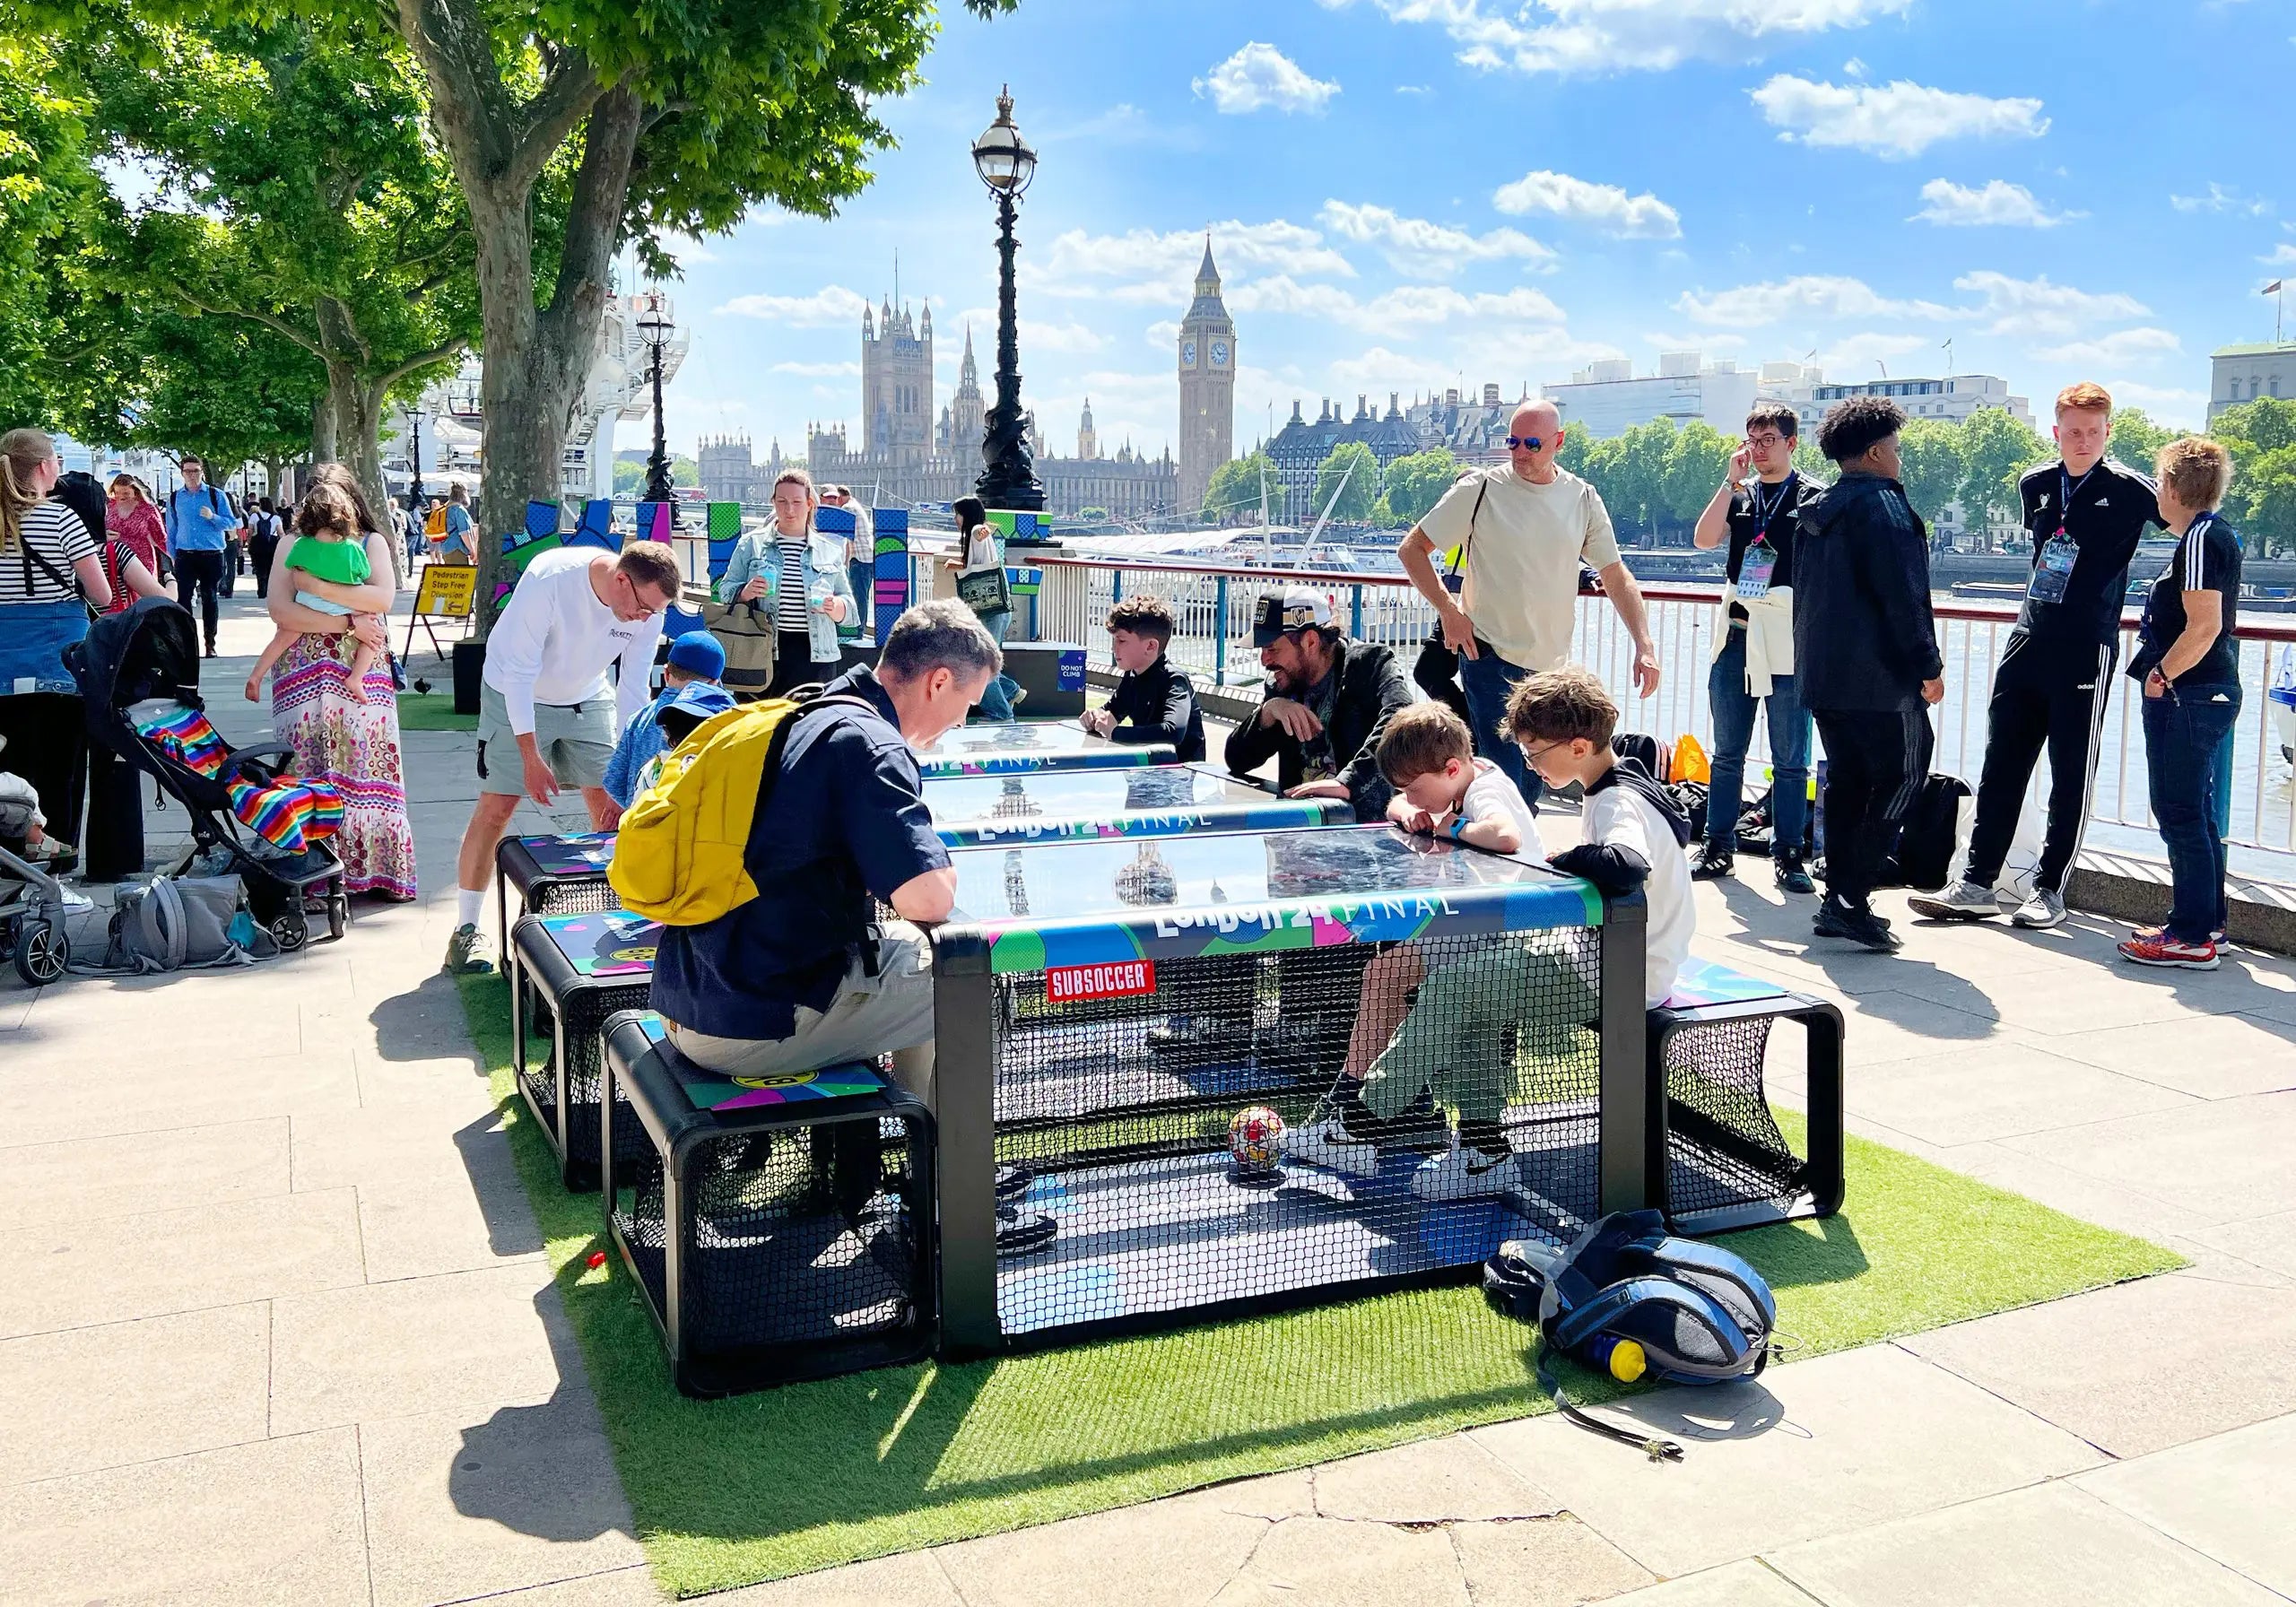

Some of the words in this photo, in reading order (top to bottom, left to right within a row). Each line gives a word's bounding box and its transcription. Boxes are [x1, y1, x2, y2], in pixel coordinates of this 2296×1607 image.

[432, 570, 469, 579] Pedestrian
[431, 580, 448, 589] Step
[450, 581, 466, 589] Free
[1122, 812, 1213, 830] FINAL
[1290, 902, 1335, 928] 24
[1343, 895, 1460, 924] FINAL
[1052, 963, 1146, 997] SUBSOCCER
